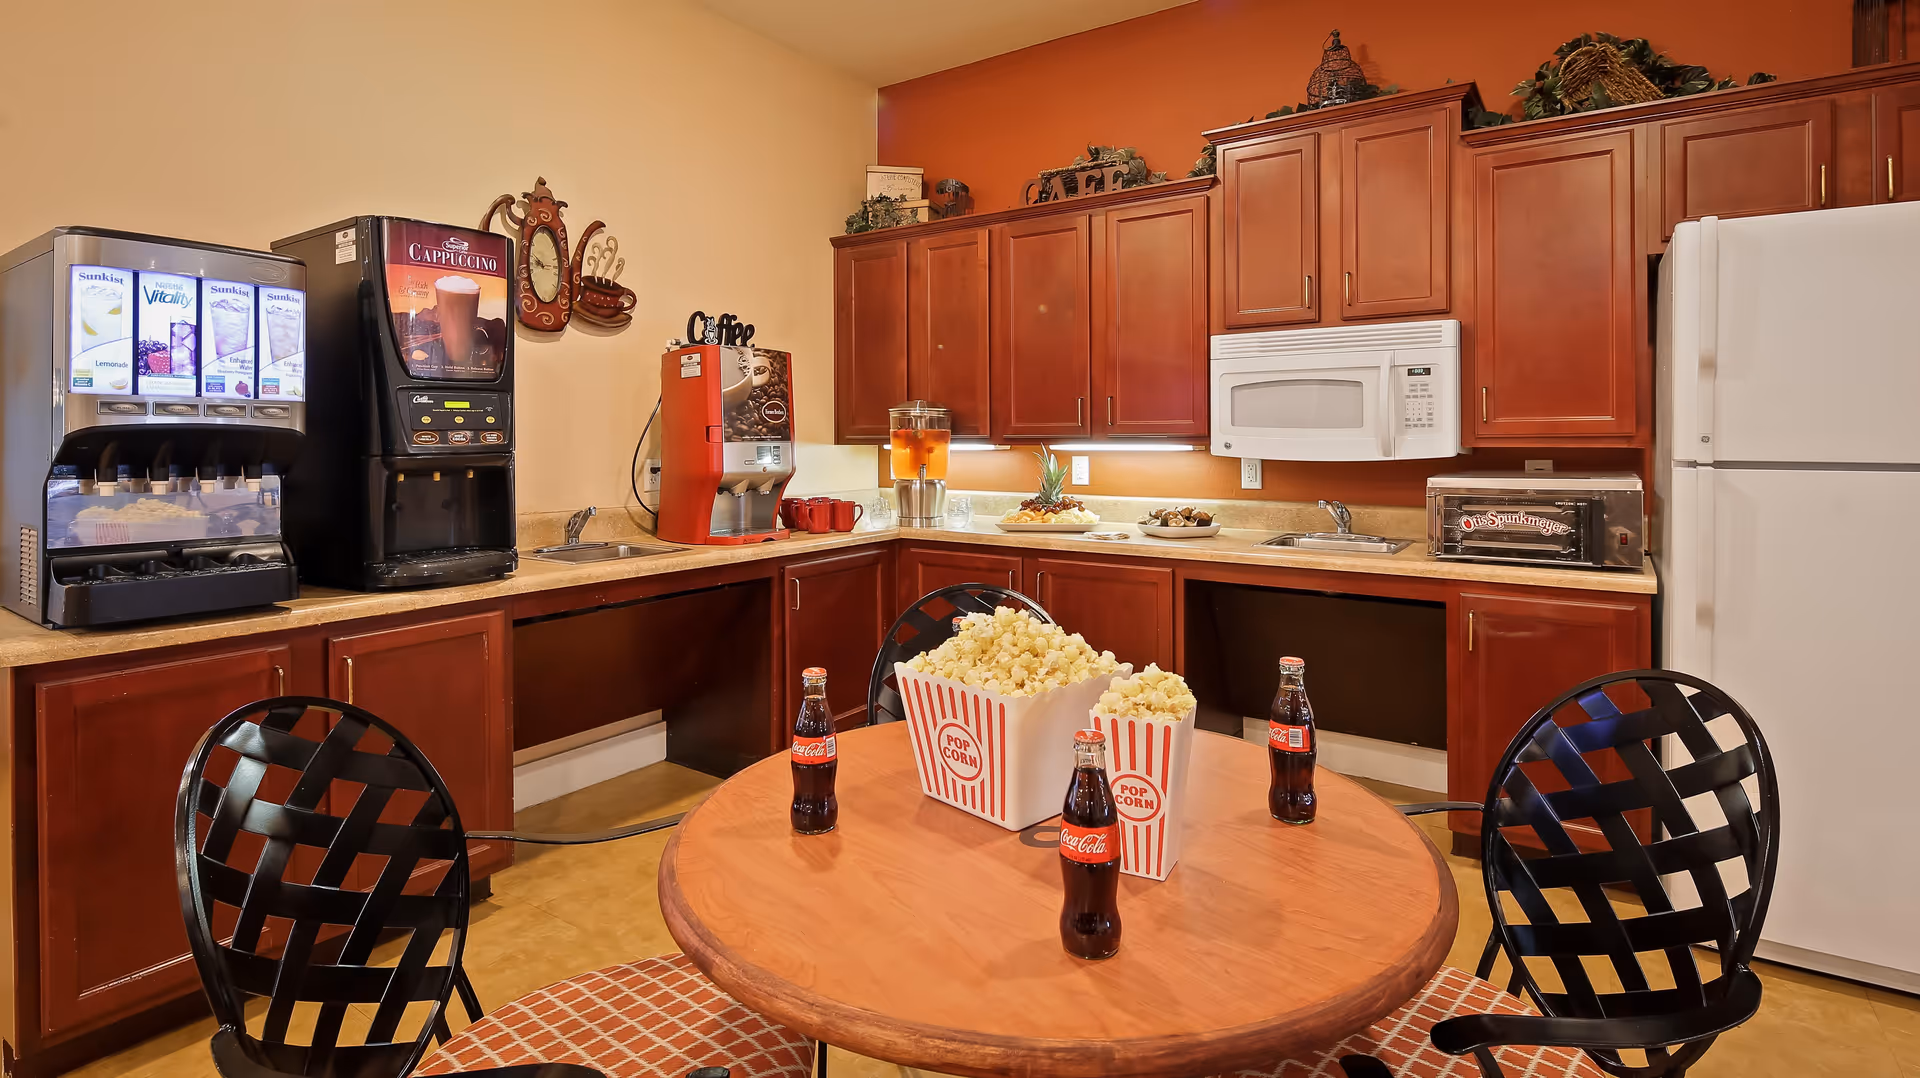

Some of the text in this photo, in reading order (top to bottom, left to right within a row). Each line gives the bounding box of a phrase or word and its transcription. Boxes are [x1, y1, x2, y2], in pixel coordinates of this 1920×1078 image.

[1020, 164, 1130, 206] CAFE
[409, 243, 497, 271] CAPPUCCINO
[79, 272, 124, 285] Sunkist
[144, 285, 193, 308] Vitality
[210, 286, 250, 298] Sunkist
[267, 293, 300, 304] Sunkist
[687, 311, 755, 348] Coffee
[1461, 514, 1488, 532] Otis
[1487, 510, 1568, 536] Spunkmeyer
[947, 734, 970, 751] POP
[943, 747, 978, 769] CORN
[1120, 784, 1148, 797] POP
[1115, 795, 1154, 810] CORN
